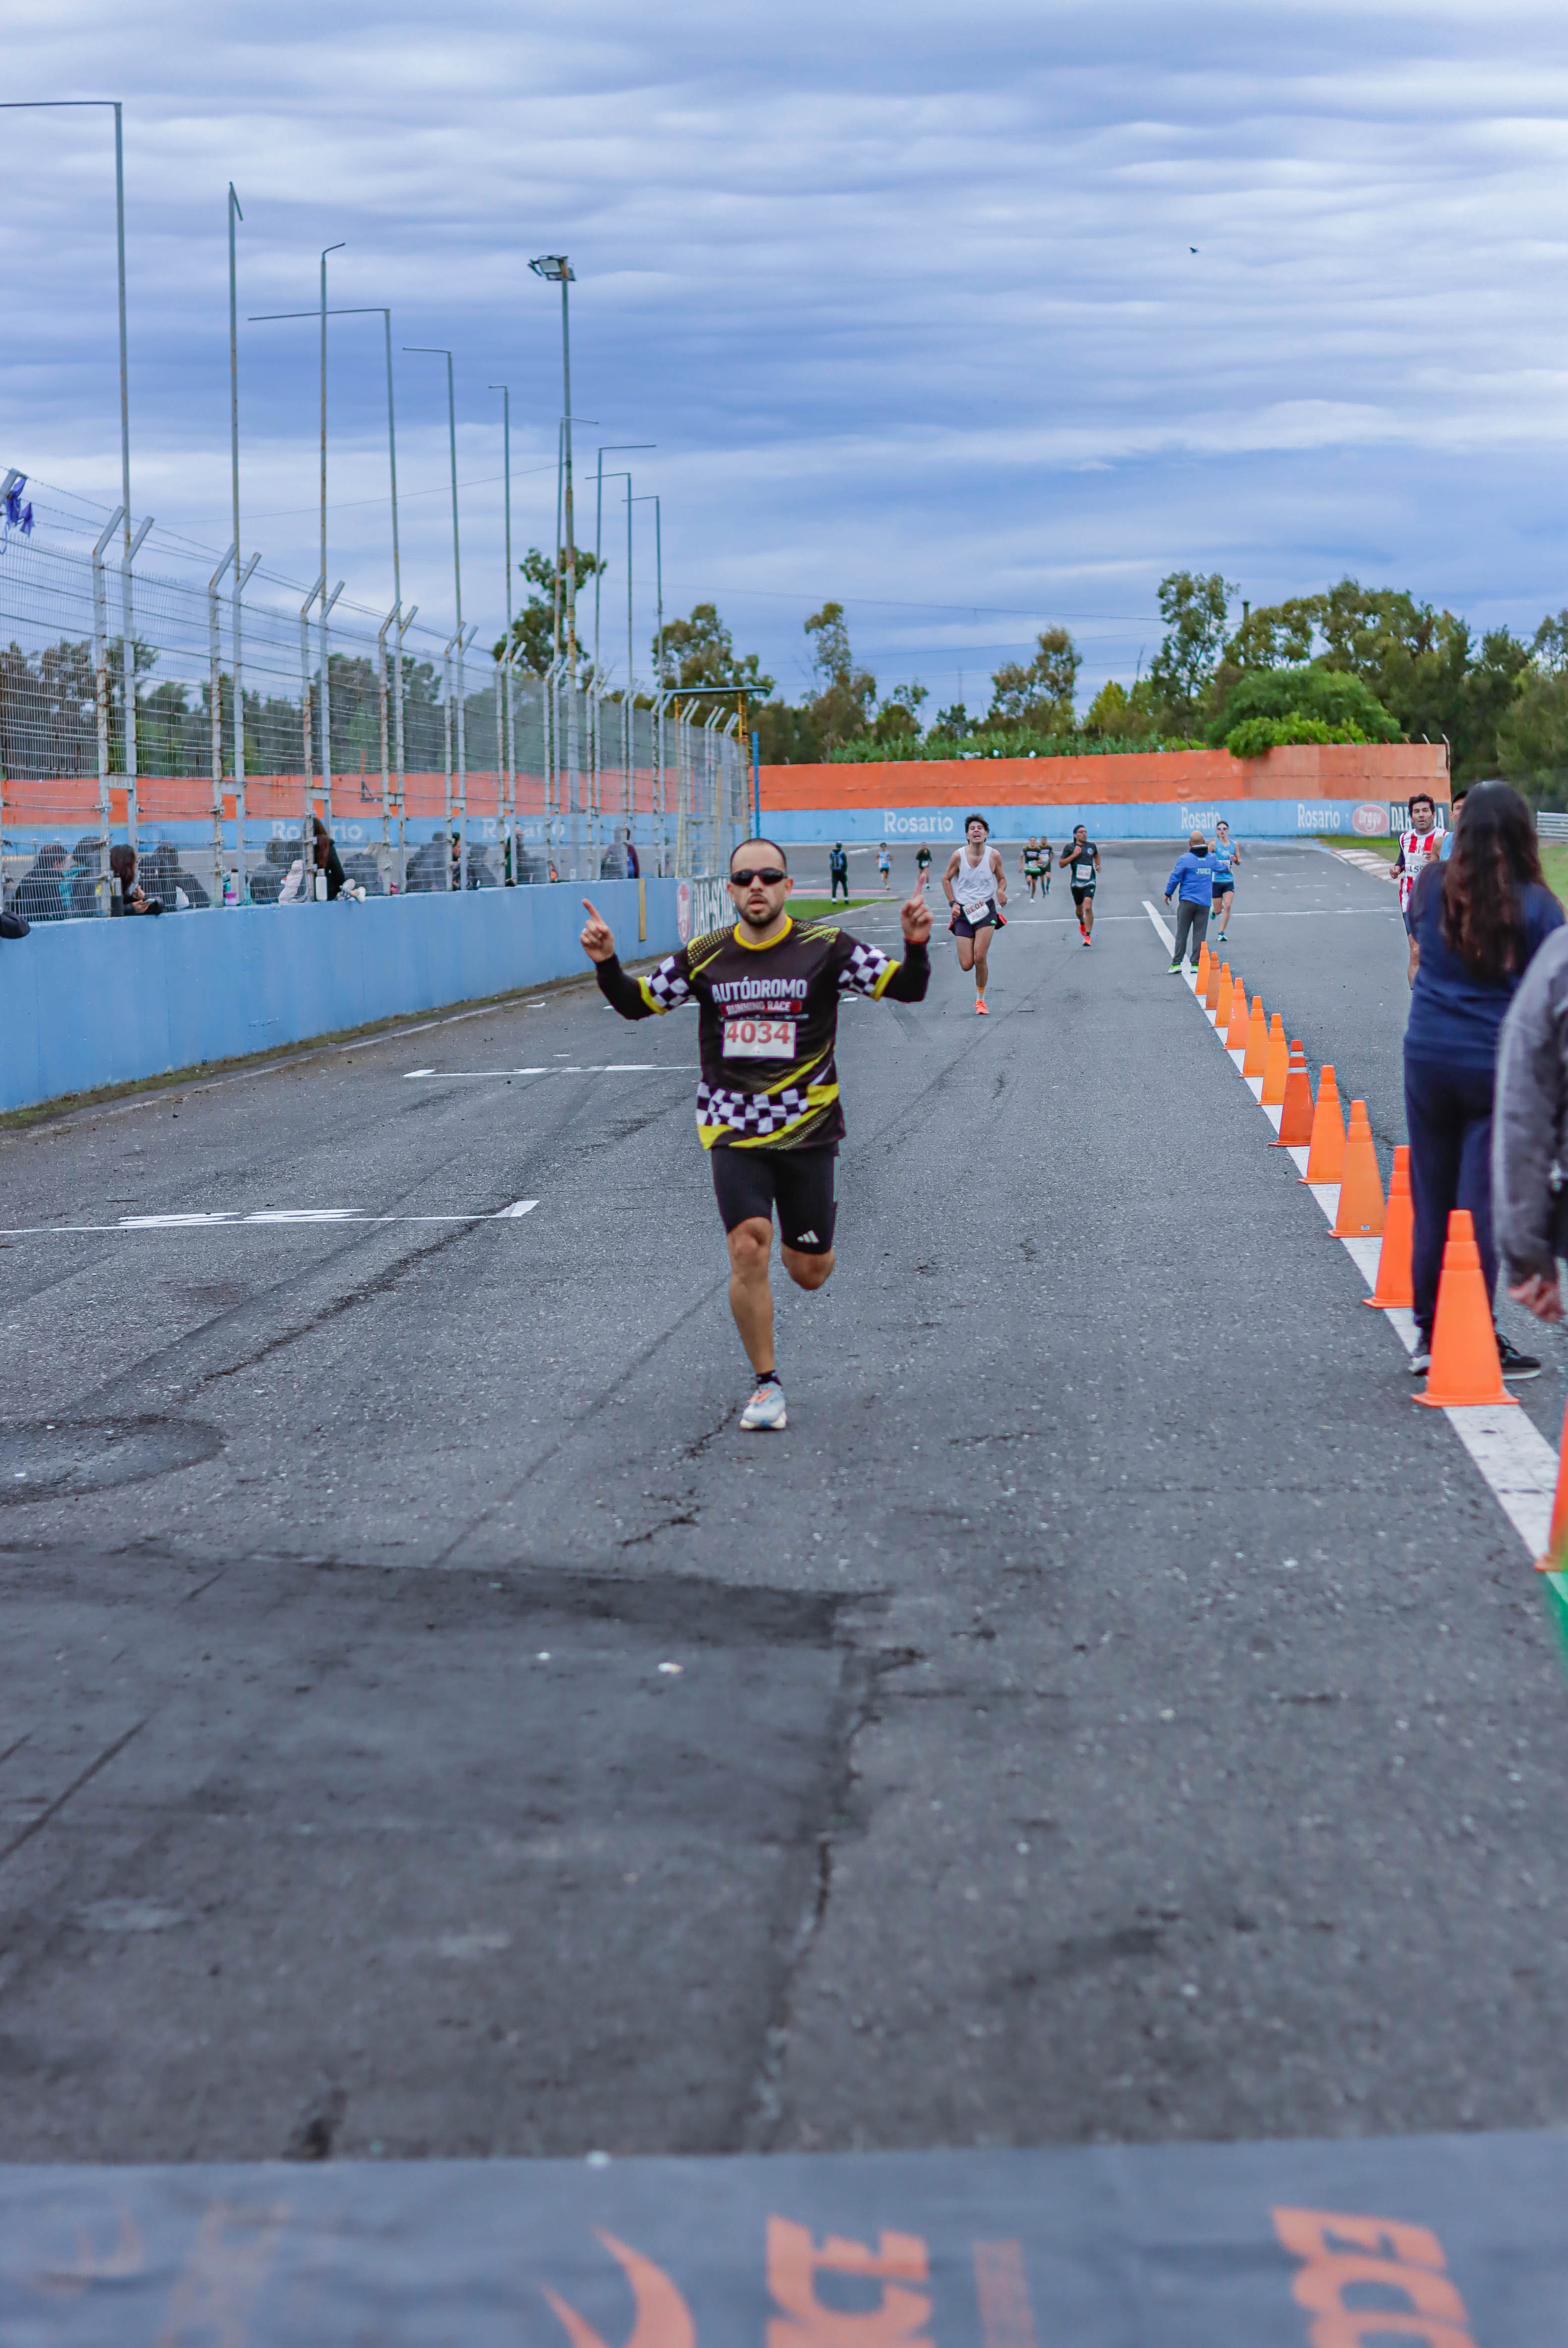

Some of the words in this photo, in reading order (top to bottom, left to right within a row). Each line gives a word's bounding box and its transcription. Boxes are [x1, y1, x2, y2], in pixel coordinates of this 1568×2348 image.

[884, 810, 953, 833] Rosario
[1297, 803, 1340, 828] Rosario
[272, 820, 362, 840] Rorio
[712, 976, 807, 1003] AUTÓDROMO
[767, 1001, 791, 1012] RACE
[726, 1021, 791, 1044] 4034
